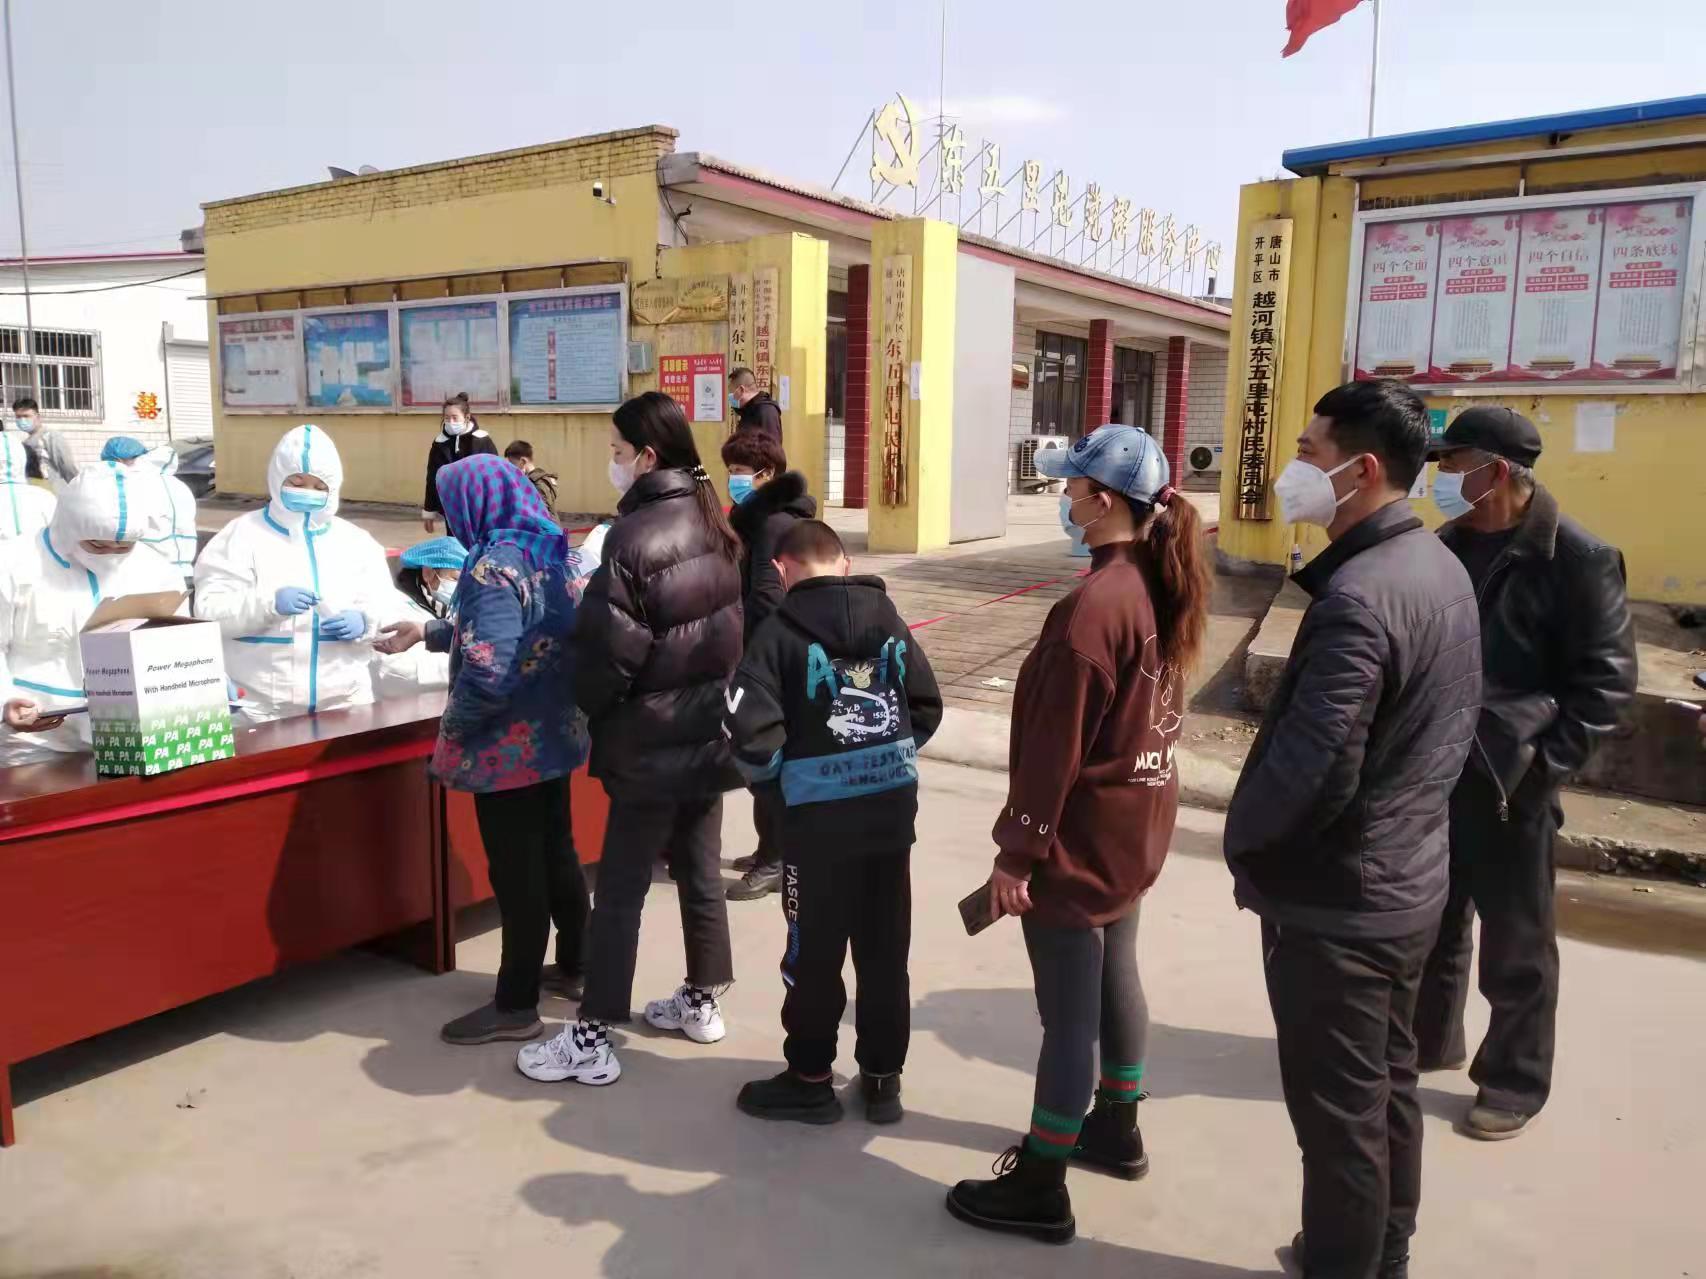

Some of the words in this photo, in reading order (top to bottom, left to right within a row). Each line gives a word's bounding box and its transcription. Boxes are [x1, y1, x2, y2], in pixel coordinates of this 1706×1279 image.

[1253, 236, 1265, 283] 开平区
[1268, 235, 1282, 282] 唐山市
[1240, 291, 1276, 504] 越河镇东五里屯村民委员会
[147, 664, 171, 672] Power
[174, 658, 213, 668] Megaphone
[144, 686, 158, 695] With
[160, 681, 187, 691] Handheld
[188, 677, 220, 687] Microphone
[152, 719, 166, 729] PA
[174, 715, 189, 725] PA
[197, 711, 210, 721] PA
[143, 735, 156, 746] PA
[164, 731, 178, 742] PA
[187, 727, 200, 738] PA
[208, 722, 223, 733] PA
[154, 748, 169, 758] PA
[177, 744, 191, 754] PA
[199, 739, 213, 749] PA
[145, 764, 160, 775] PA
[168, 760, 182, 770] PA
[191, 754, 205, 765] PA
[212, 750, 226, 760] PA
[787, 864, 799, 922] PASCE
